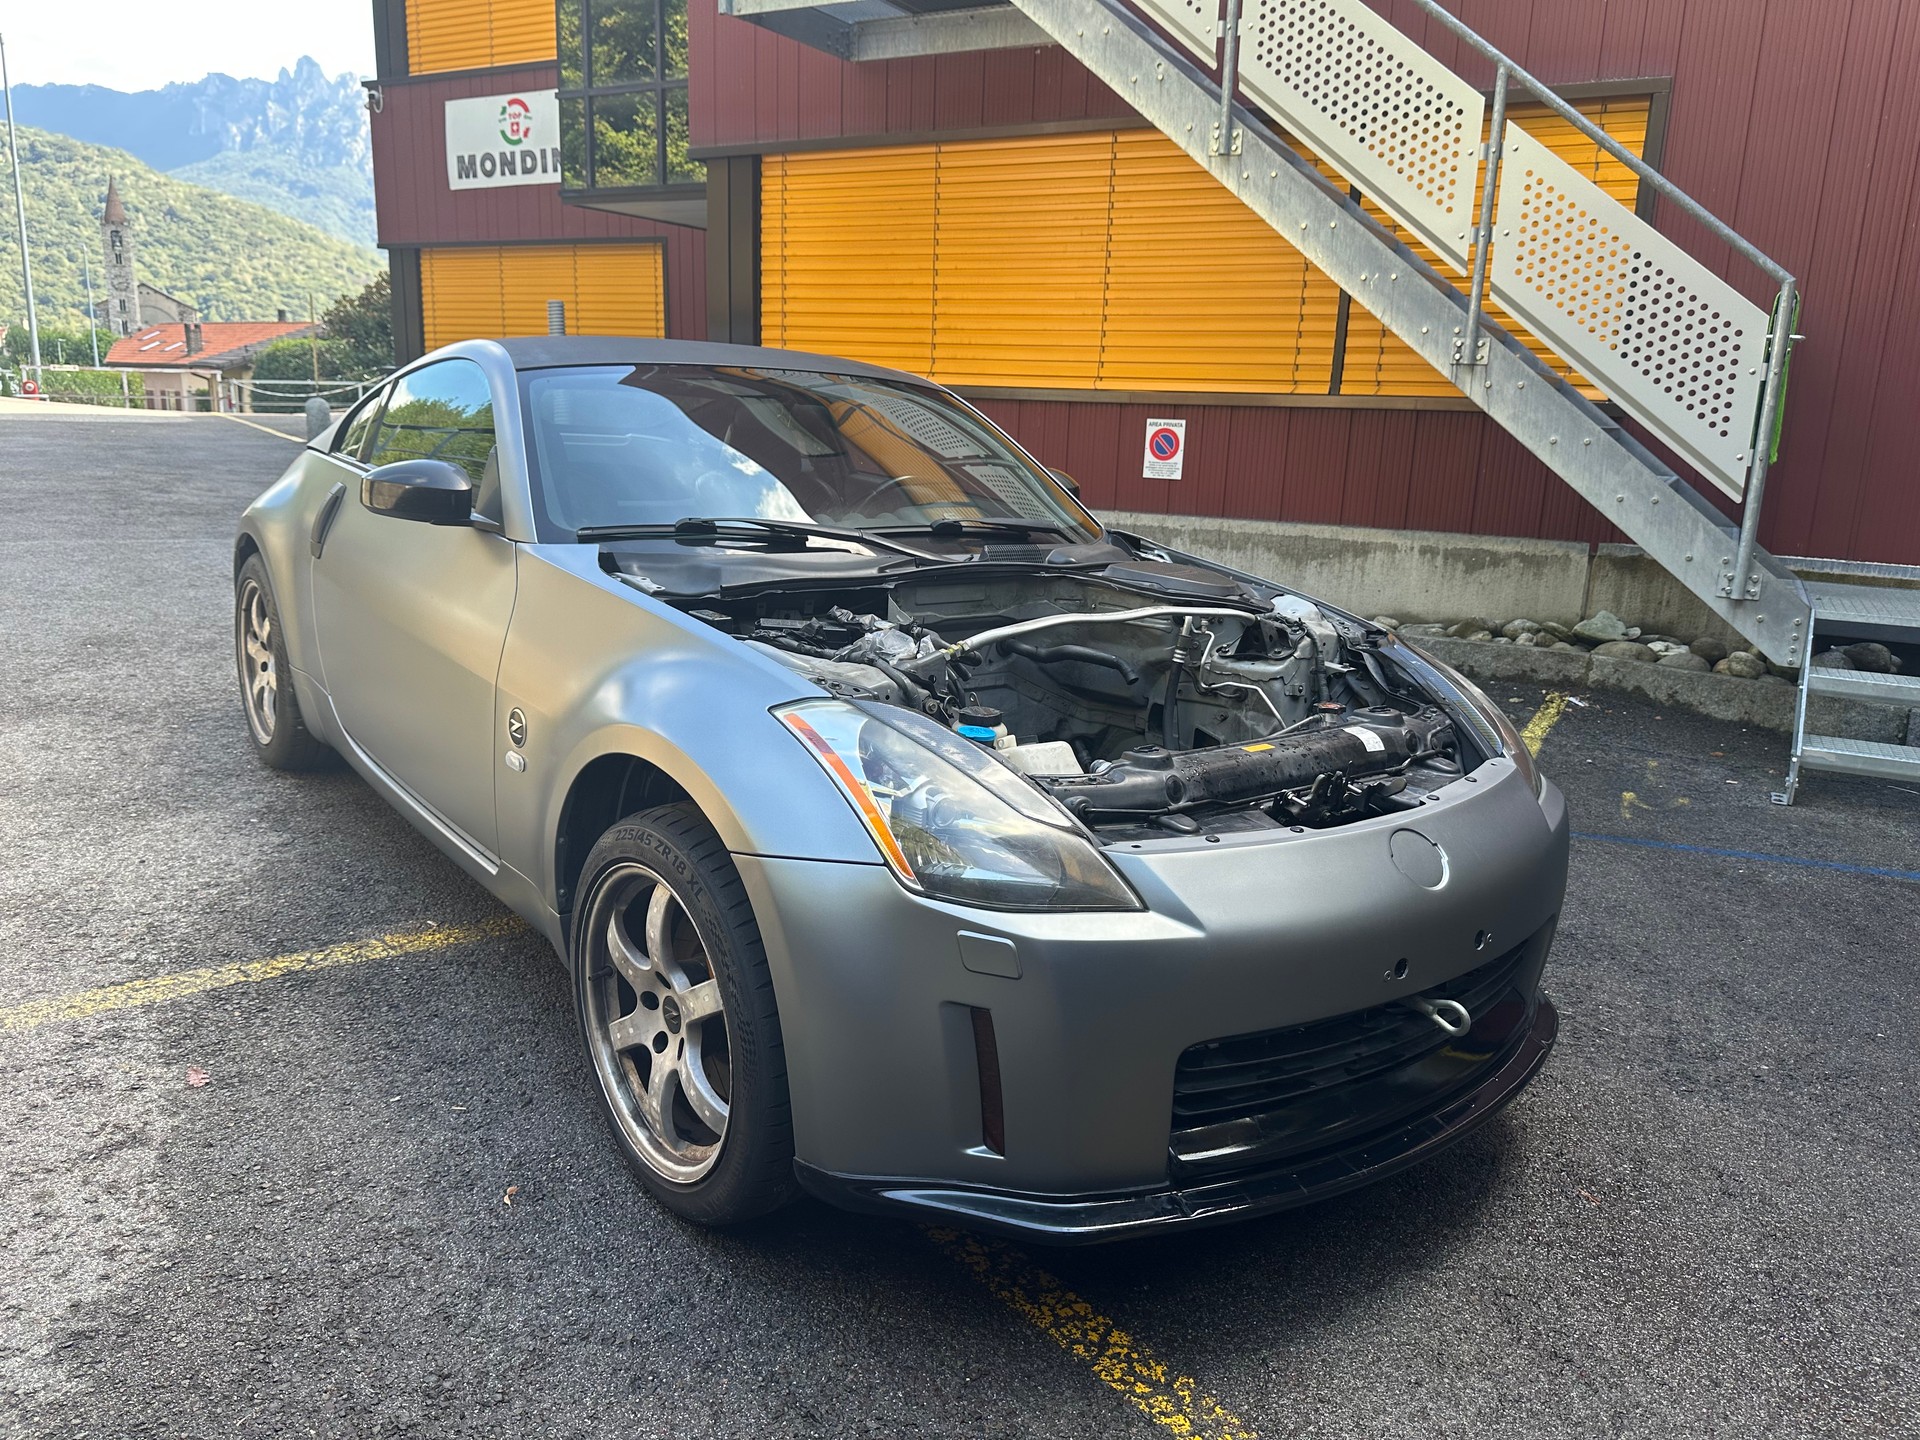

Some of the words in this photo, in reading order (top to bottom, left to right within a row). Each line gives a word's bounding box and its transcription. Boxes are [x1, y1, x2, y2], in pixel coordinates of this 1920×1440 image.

[615, 829, 652, 846] 225/45
[654, 839, 672, 861] ZR
[671, 855, 687, 876] 18
[687, 873, 703, 903] XL
